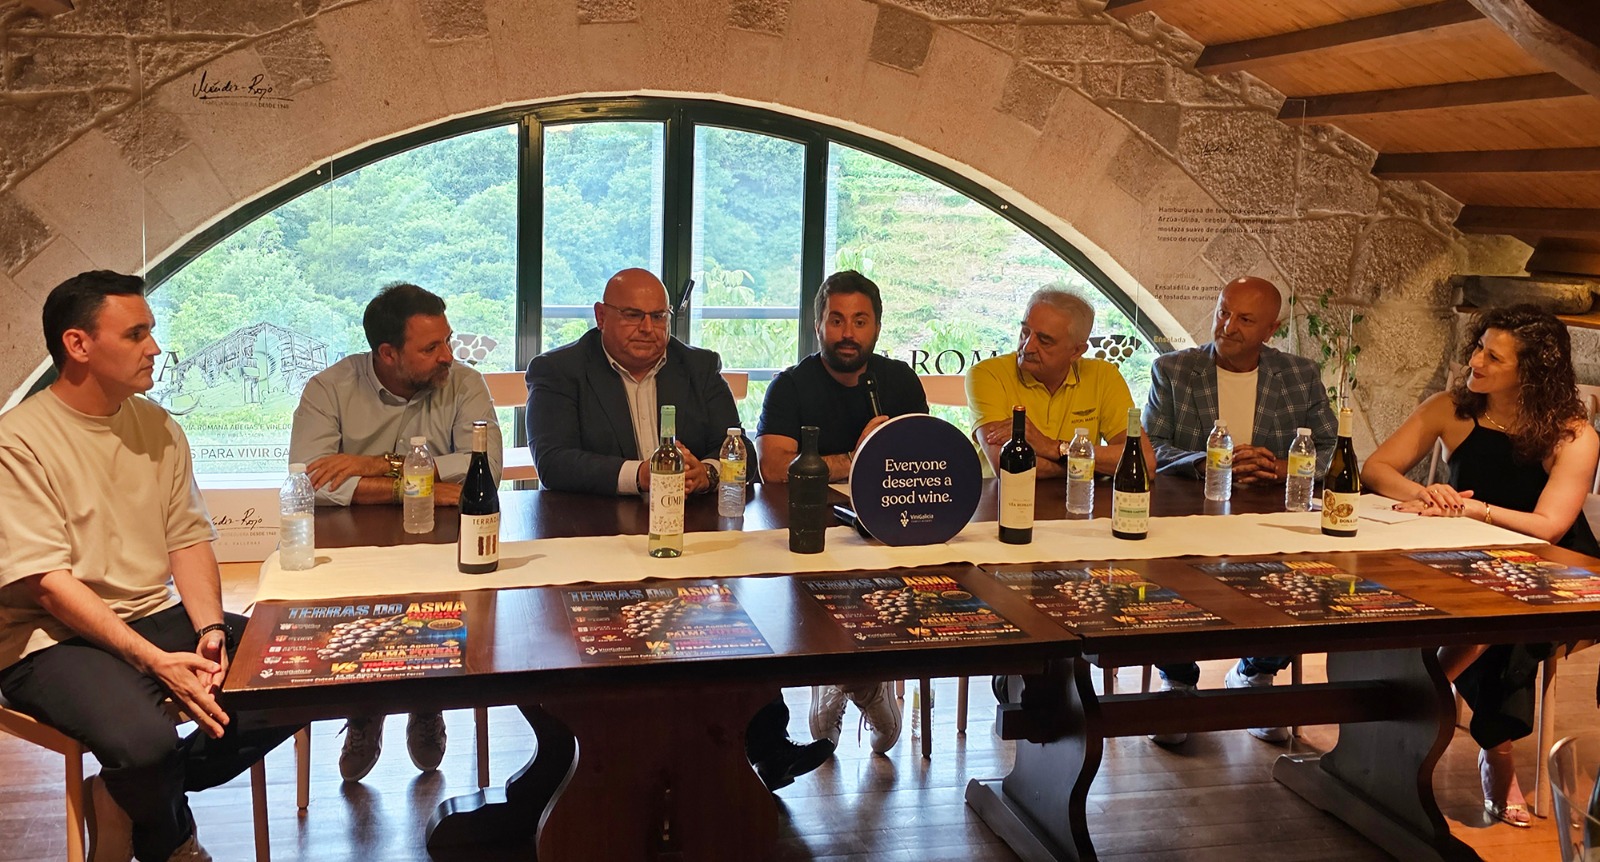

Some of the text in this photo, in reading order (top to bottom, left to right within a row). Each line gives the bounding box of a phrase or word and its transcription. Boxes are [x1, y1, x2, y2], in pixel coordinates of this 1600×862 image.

[1158, 206, 1204, 214] Hamburguesa
[201, 448, 234, 459] PARA
[237, 448, 270, 458] VIVIR
[885, 458, 947, 474] Everyone
[882, 475, 953, 489] deserves a
[881, 490, 953, 508] good wine.
[902, 575, 957, 586] ASMA
[568, 589, 645, 602] TERRAS
[646, 588, 674, 600] DO
[677, 584, 732, 598] ASMA
[288, 600, 467, 620] TERRAS DO ASMA
[666, 630, 707, 639] PALMA
[360, 649, 407, 660] PALMA
